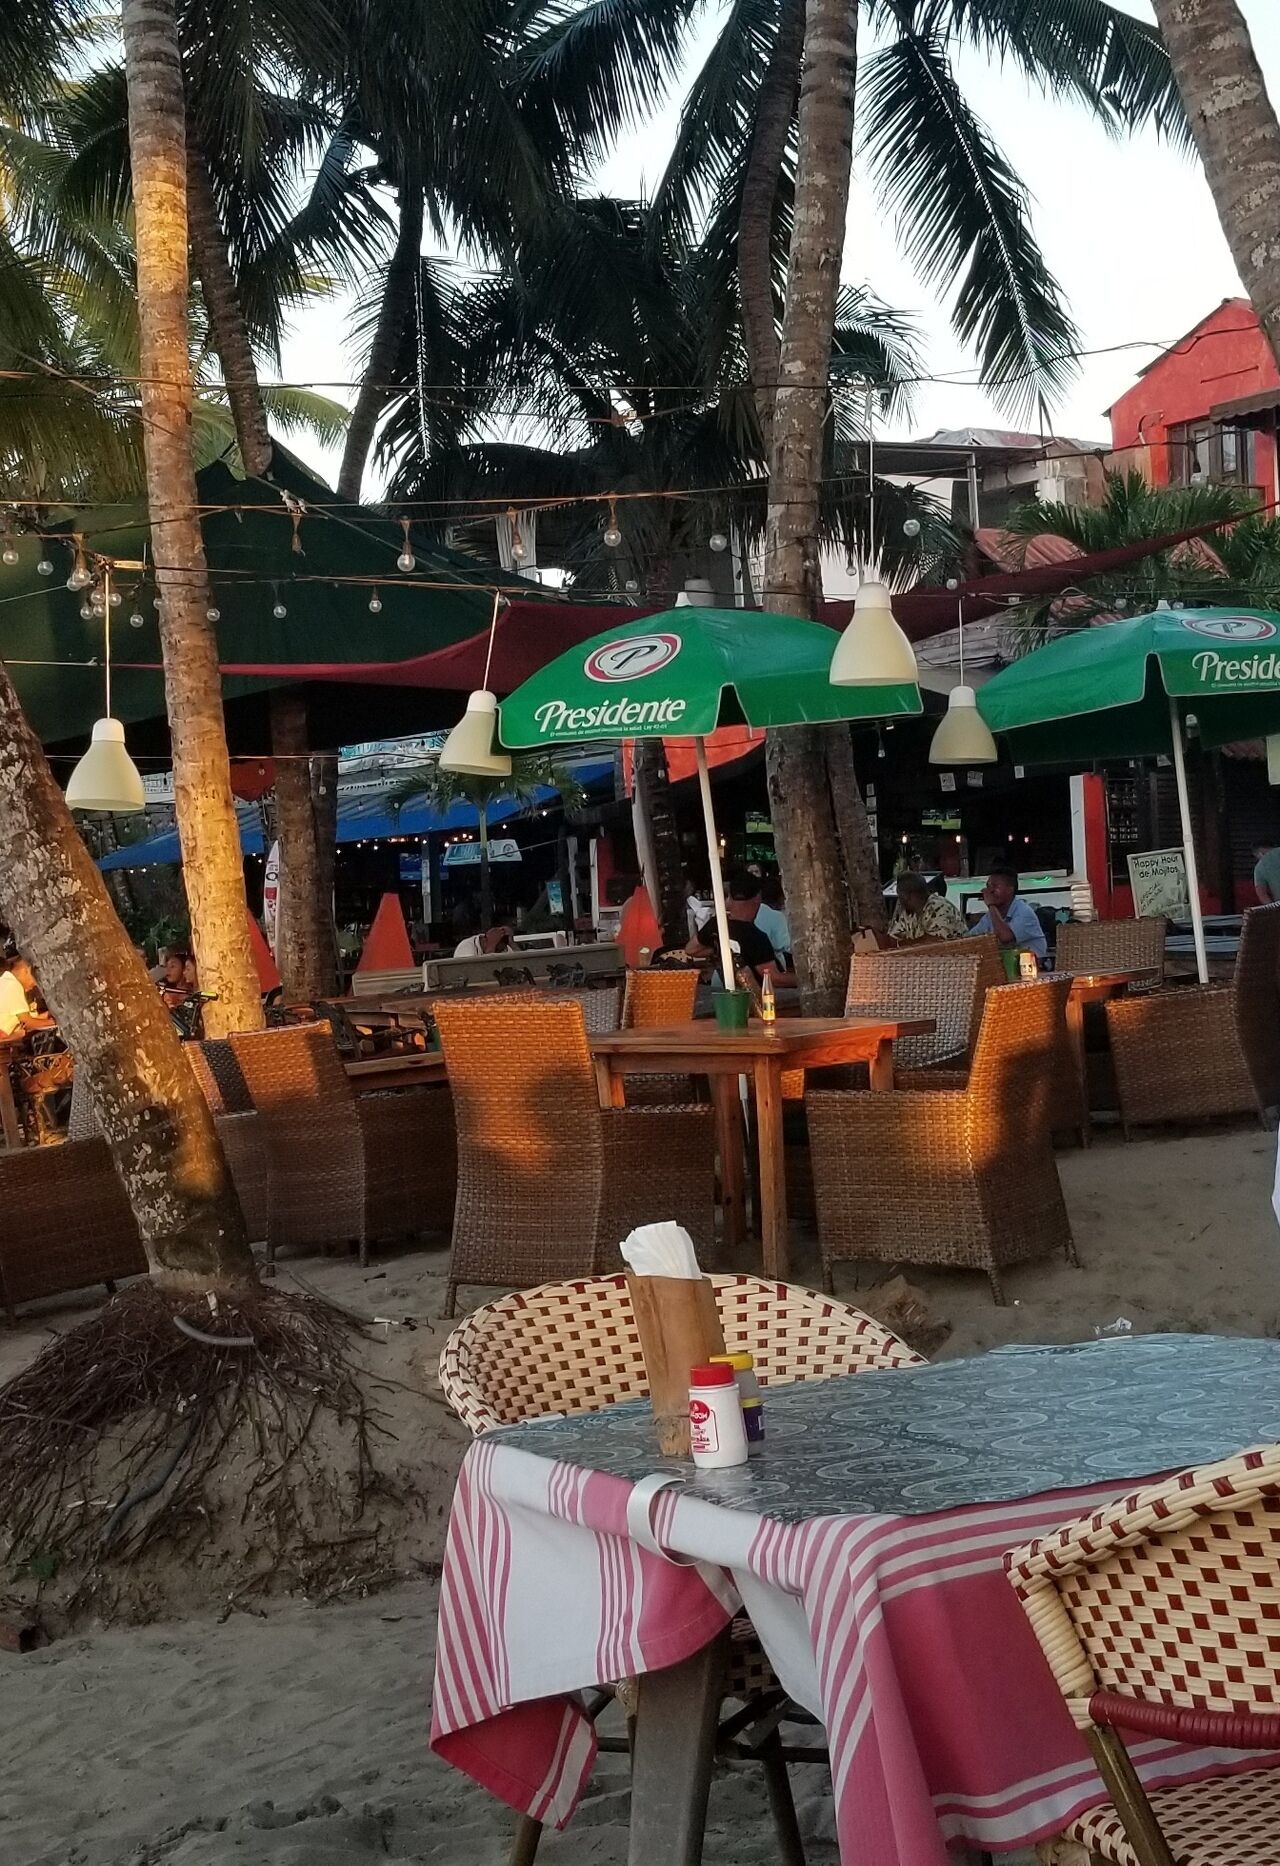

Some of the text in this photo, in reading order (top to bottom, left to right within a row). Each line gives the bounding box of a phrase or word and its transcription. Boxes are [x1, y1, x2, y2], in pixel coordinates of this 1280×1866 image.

[534, 697, 686, 733] Presidente
[1134, 855, 1178, 869] Happy Hour
